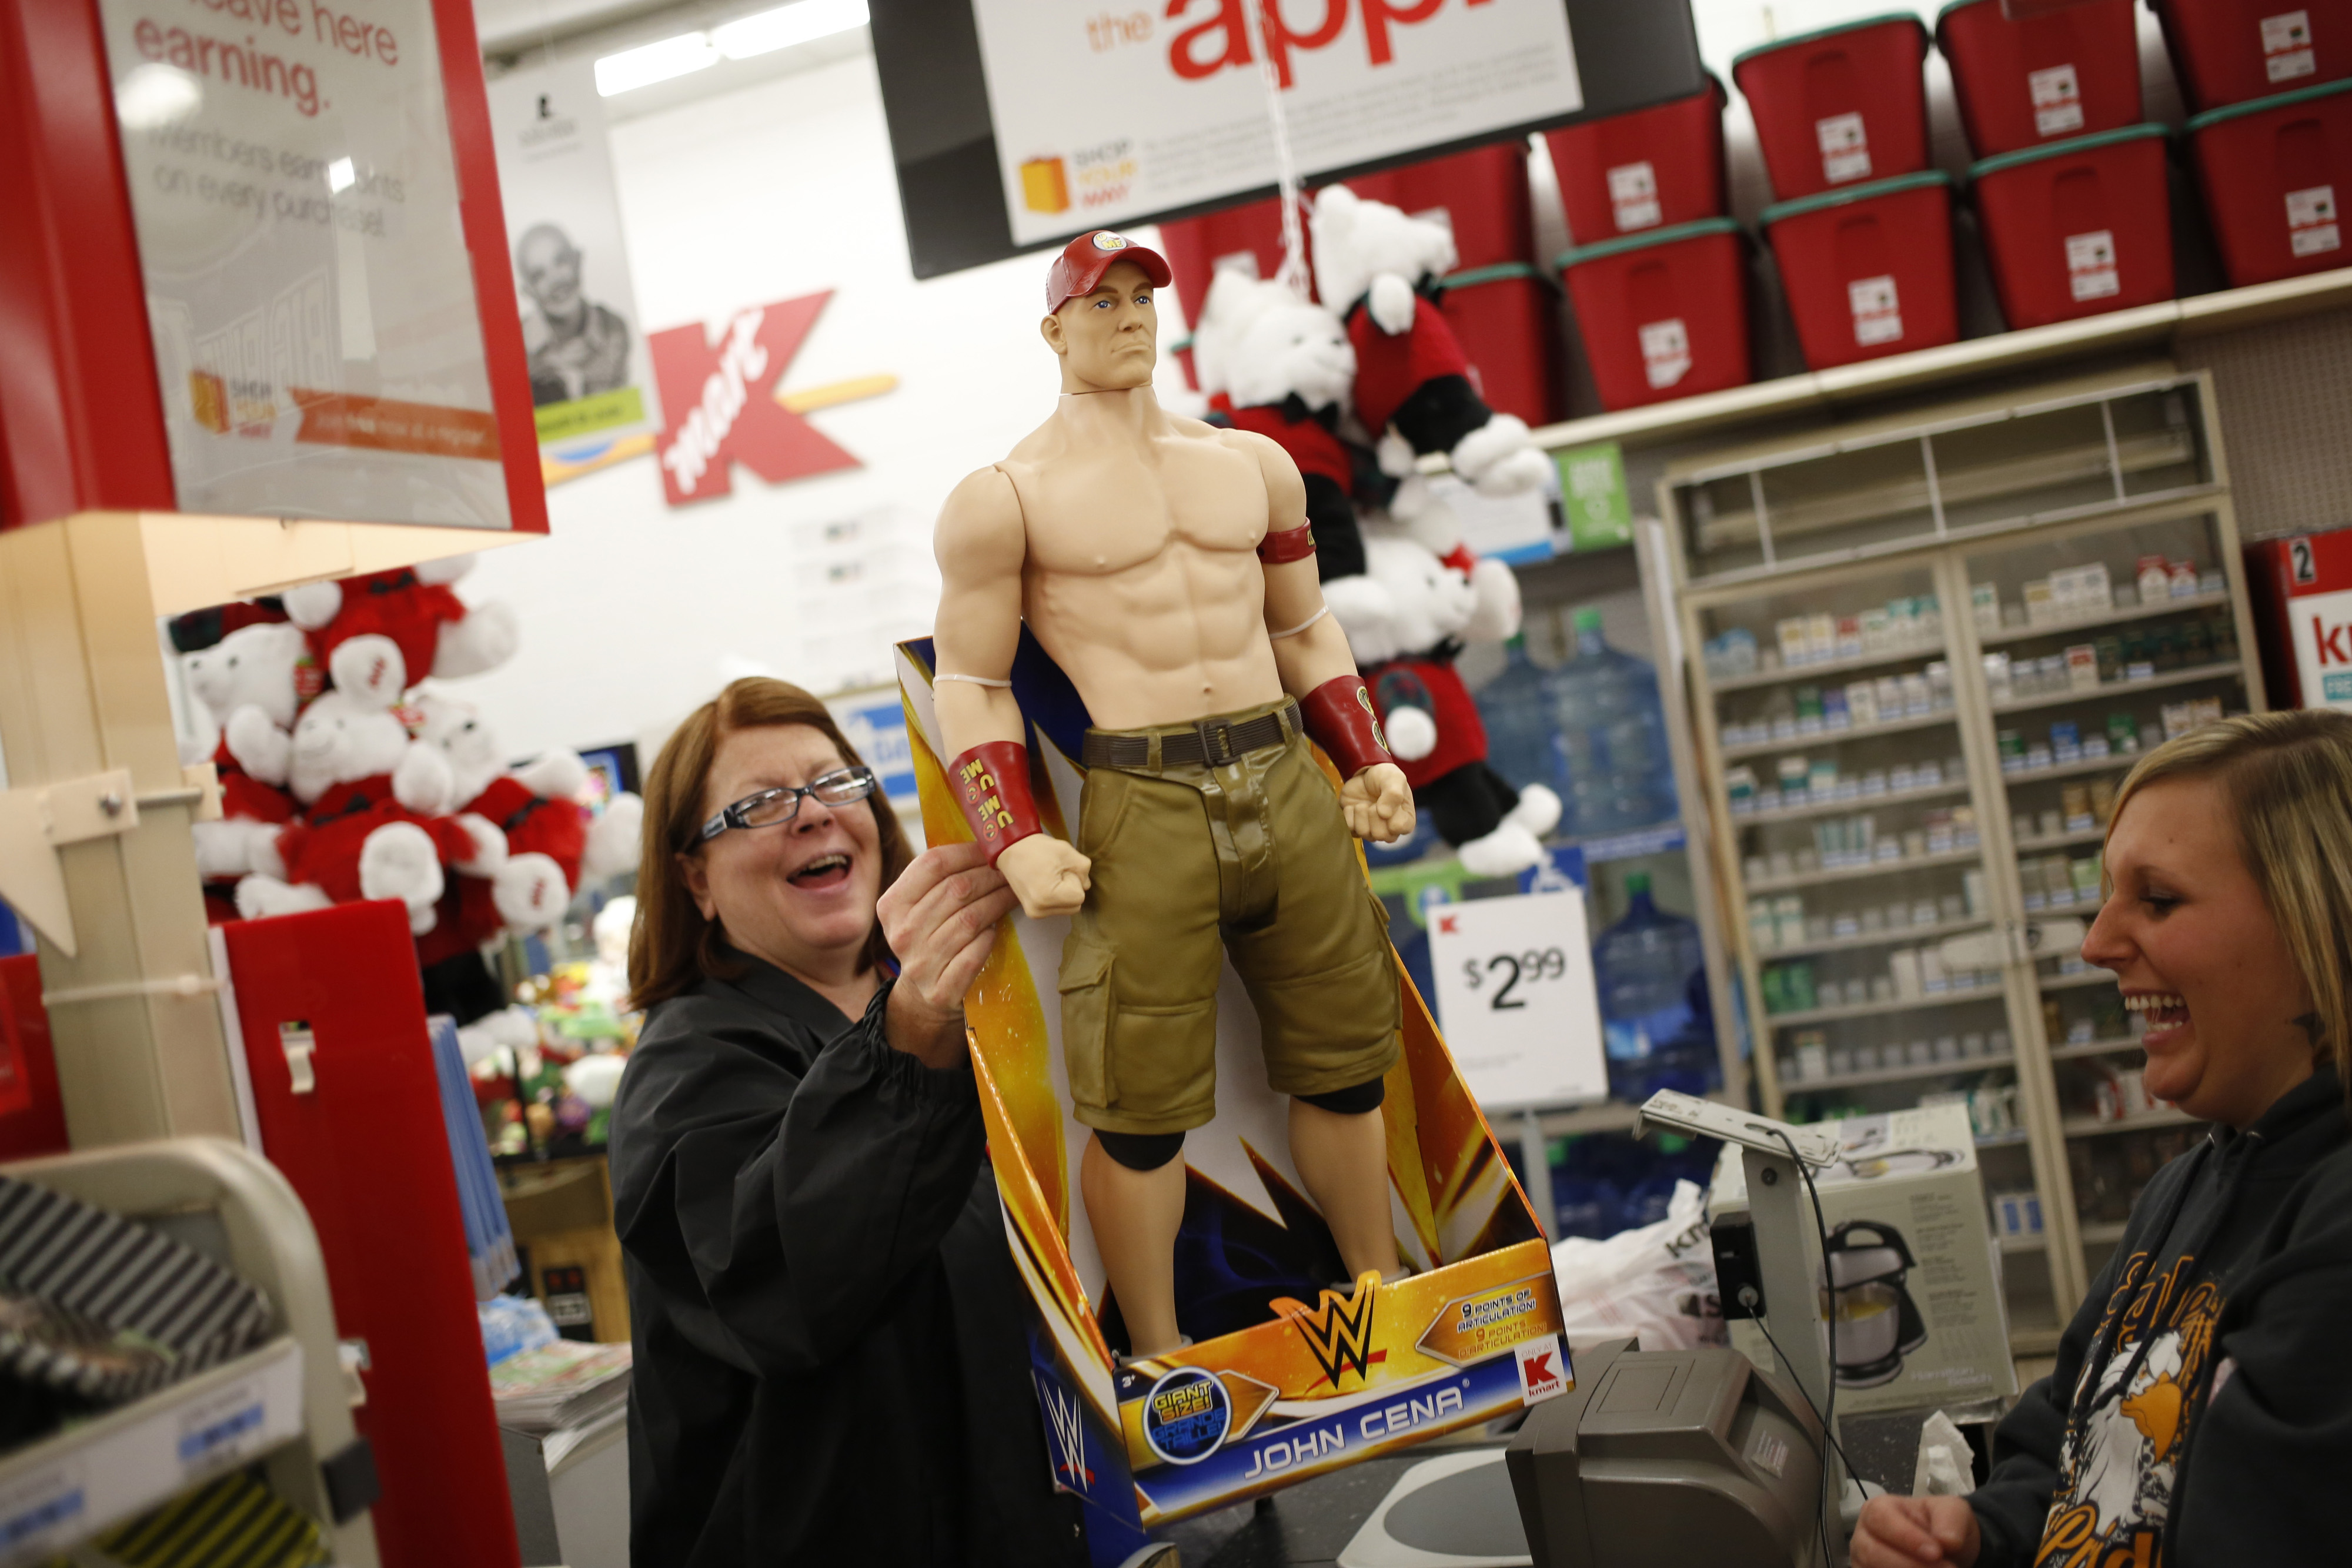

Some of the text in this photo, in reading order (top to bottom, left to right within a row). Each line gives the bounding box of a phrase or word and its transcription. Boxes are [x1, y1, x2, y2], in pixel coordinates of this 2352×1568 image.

[310, 0, 399, 65] here
[1085, 9, 1154, 53] the
[133, 16, 330, 118] earning.
[1074, 139, 1135, 166] SHOP
[1101, 239, 1124, 250] ME
[2293, 543, 2313, 580] 2
[960, 758, 984, 785] ME
[978, 795, 1001, 821] ME
[1457, 1299, 1536, 1333] ARTICULATION!
[1462, 1288, 1532, 1318] 9 POINTS OF
[1475, 1319, 1526, 1342] 9 POINTS
[1522, 1342, 1553, 1358] ONLY AT
[1153, 1381, 1212, 1409] GIANT
[1529, 1380, 1561, 1398] kmart
[1152, 1406, 1227, 1440] GRANDE
[1160, 1396, 1211, 1422] SIZE!
[1245, 1423, 1347, 1479] JOHN
[1359, 1386, 1464, 1440] CENA
